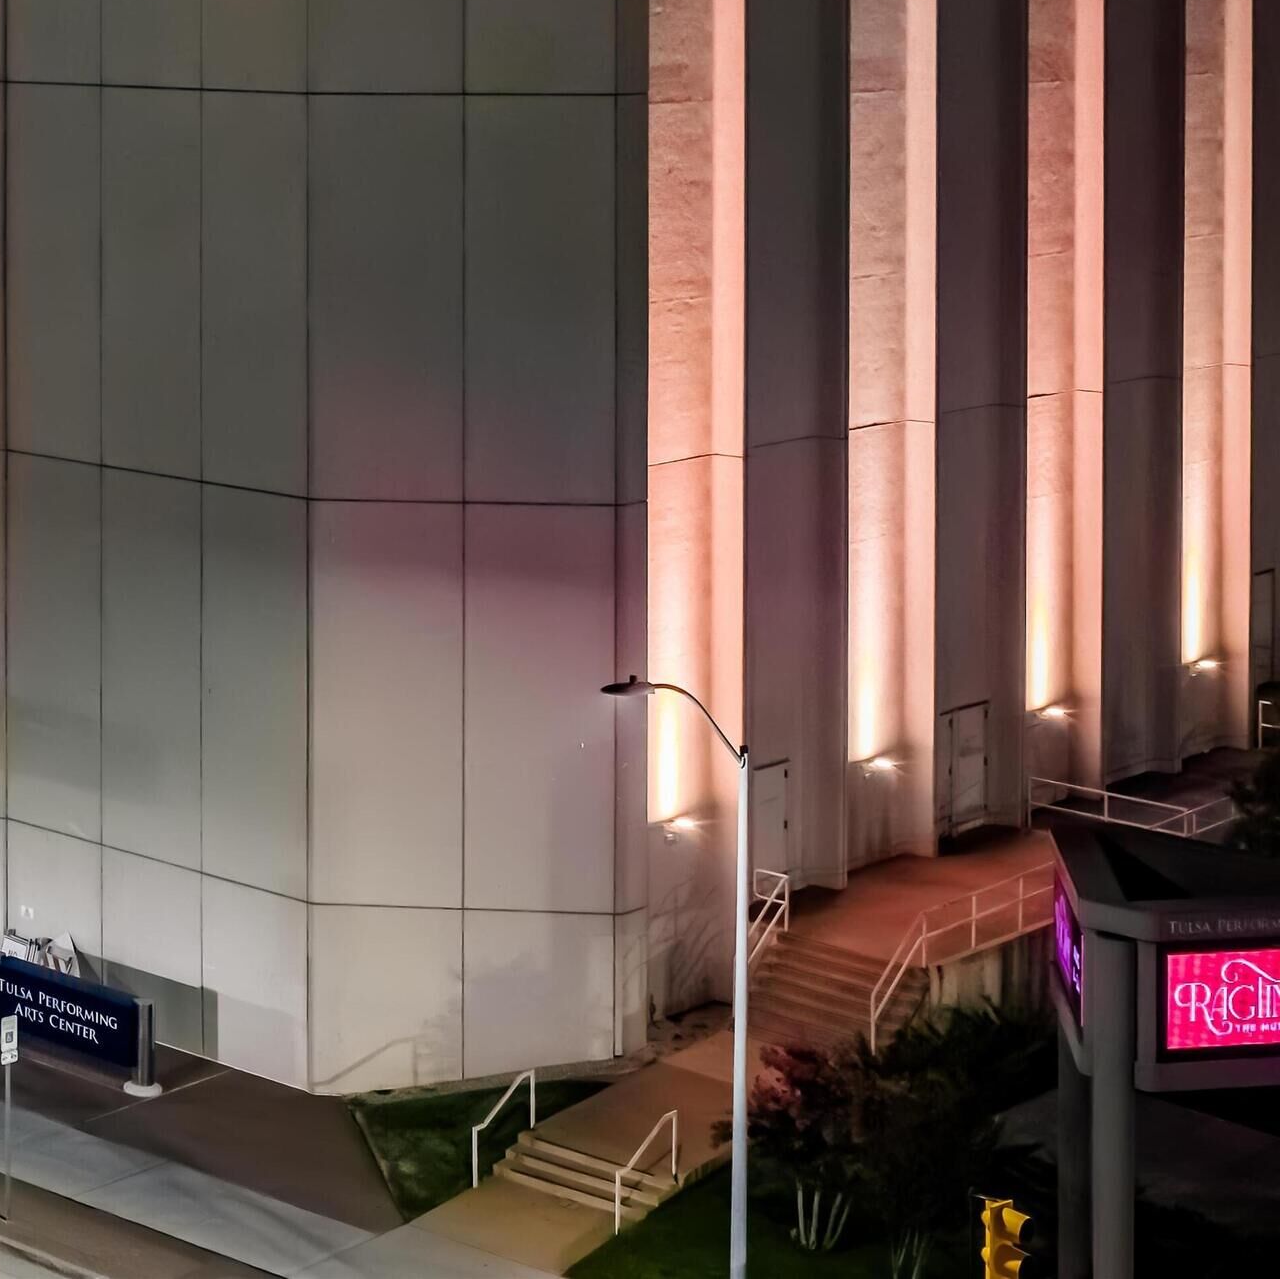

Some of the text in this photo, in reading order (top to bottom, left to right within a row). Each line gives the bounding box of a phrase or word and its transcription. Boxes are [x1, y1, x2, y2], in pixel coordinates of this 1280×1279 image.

[1169, 920, 1211, 935] TULSA
[14, 1002, 44, 1023] ARTS
[49, 1013, 99, 1045] CENTER
[38, 990, 118, 1030] PERFORMING
[1235, 1023, 1257, 1034] THE
